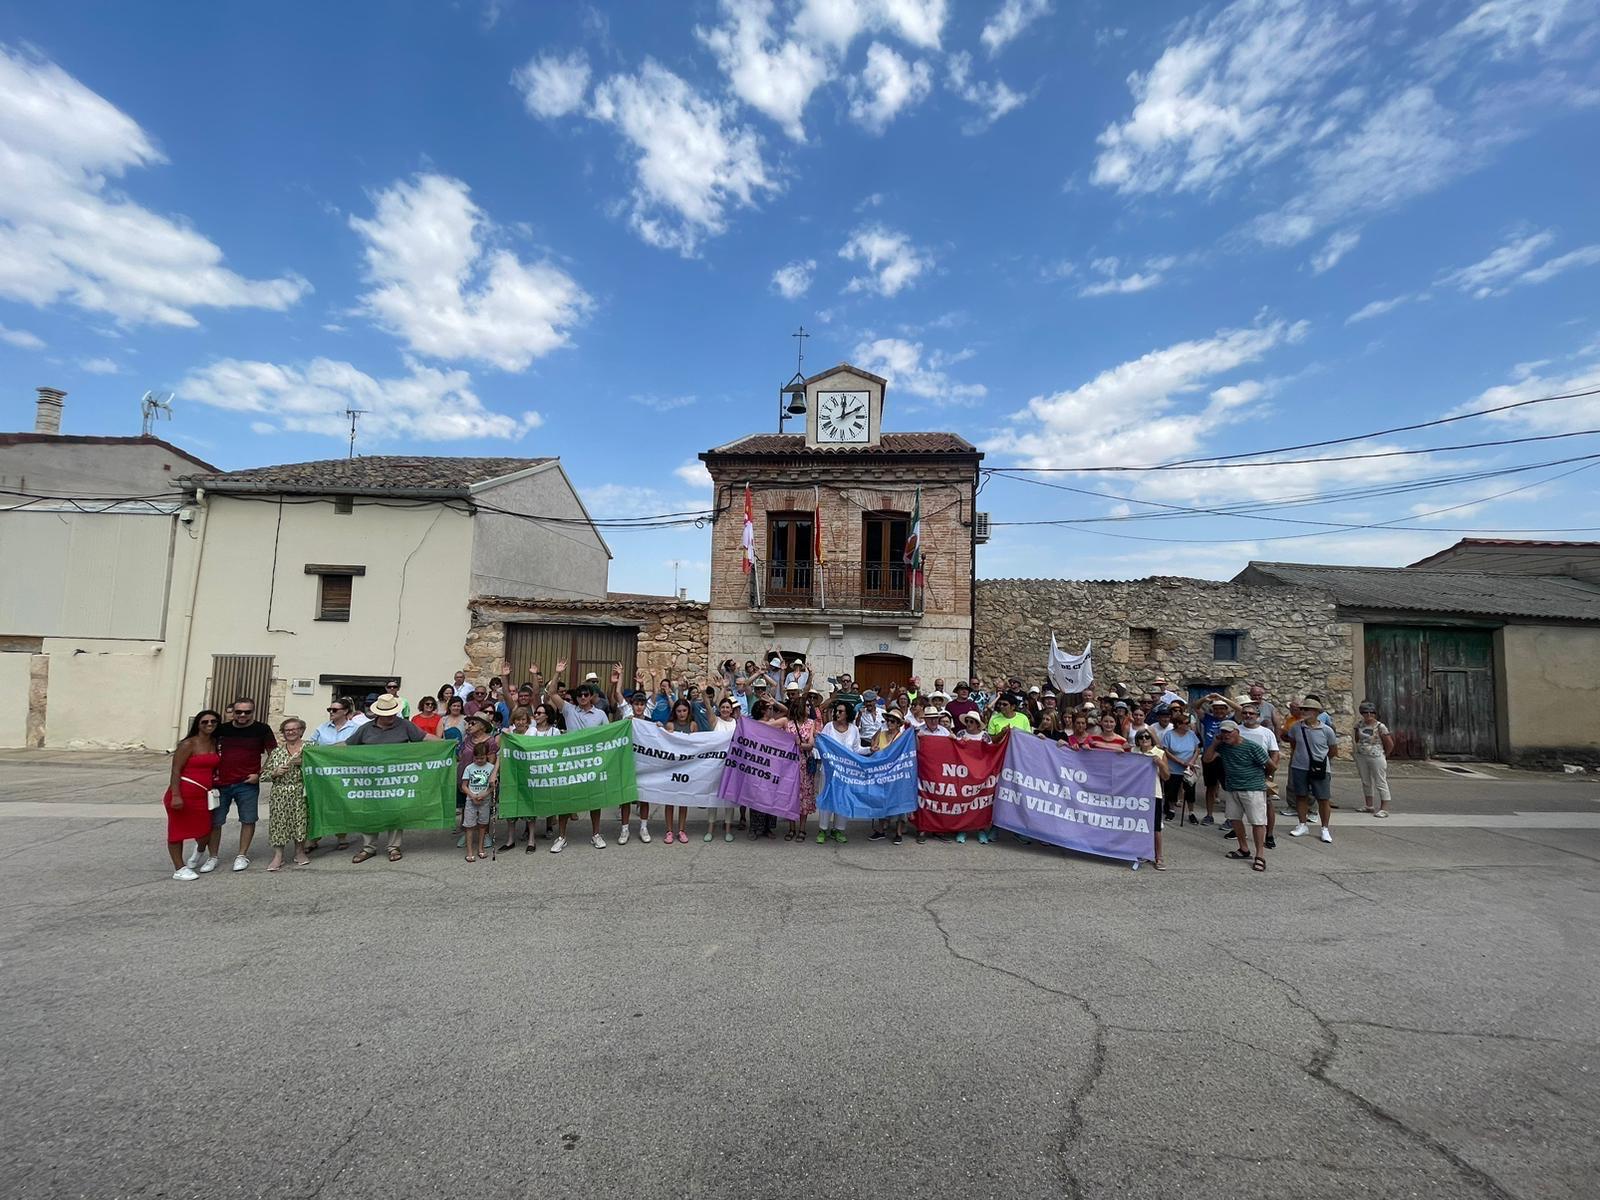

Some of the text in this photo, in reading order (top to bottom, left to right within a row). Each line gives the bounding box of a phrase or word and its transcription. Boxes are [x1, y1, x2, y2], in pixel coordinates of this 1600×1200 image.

[513, 748, 558, 760] QUIERO
[562, 744, 593, 758] AIRE
[596, 736, 630, 752] SANO
[632, 744, 676, 760] GRANJA
[730, 746, 771, 767] NI PARA
[737, 736, 800, 761] CON NITRAT
[315, 766, 384, 776] QUEREMOS
[387, 762, 422, 773] BUEN
[425, 758, 453, 770] VINO
[530, 756, 602, 774] SIN TANTO
[724, 758, 738, 768] OS
[739, 763, 771, 780] GATOS
[942, 763, 968, 778] NO
[342, 778, 350, 787] Y
[374, 775, 418, 785] TANTO
[528, 772, 596, 788] MARRANO
[671, 772, 690, 782] NO
[1060, 766, 1088, 784] NO
[347, 788, 405, 799] GORRINO
[1001, 768, 1150, 812] GRANJA CERDOS
[998, 786, 1150, 834] EN VILLATUELDA
